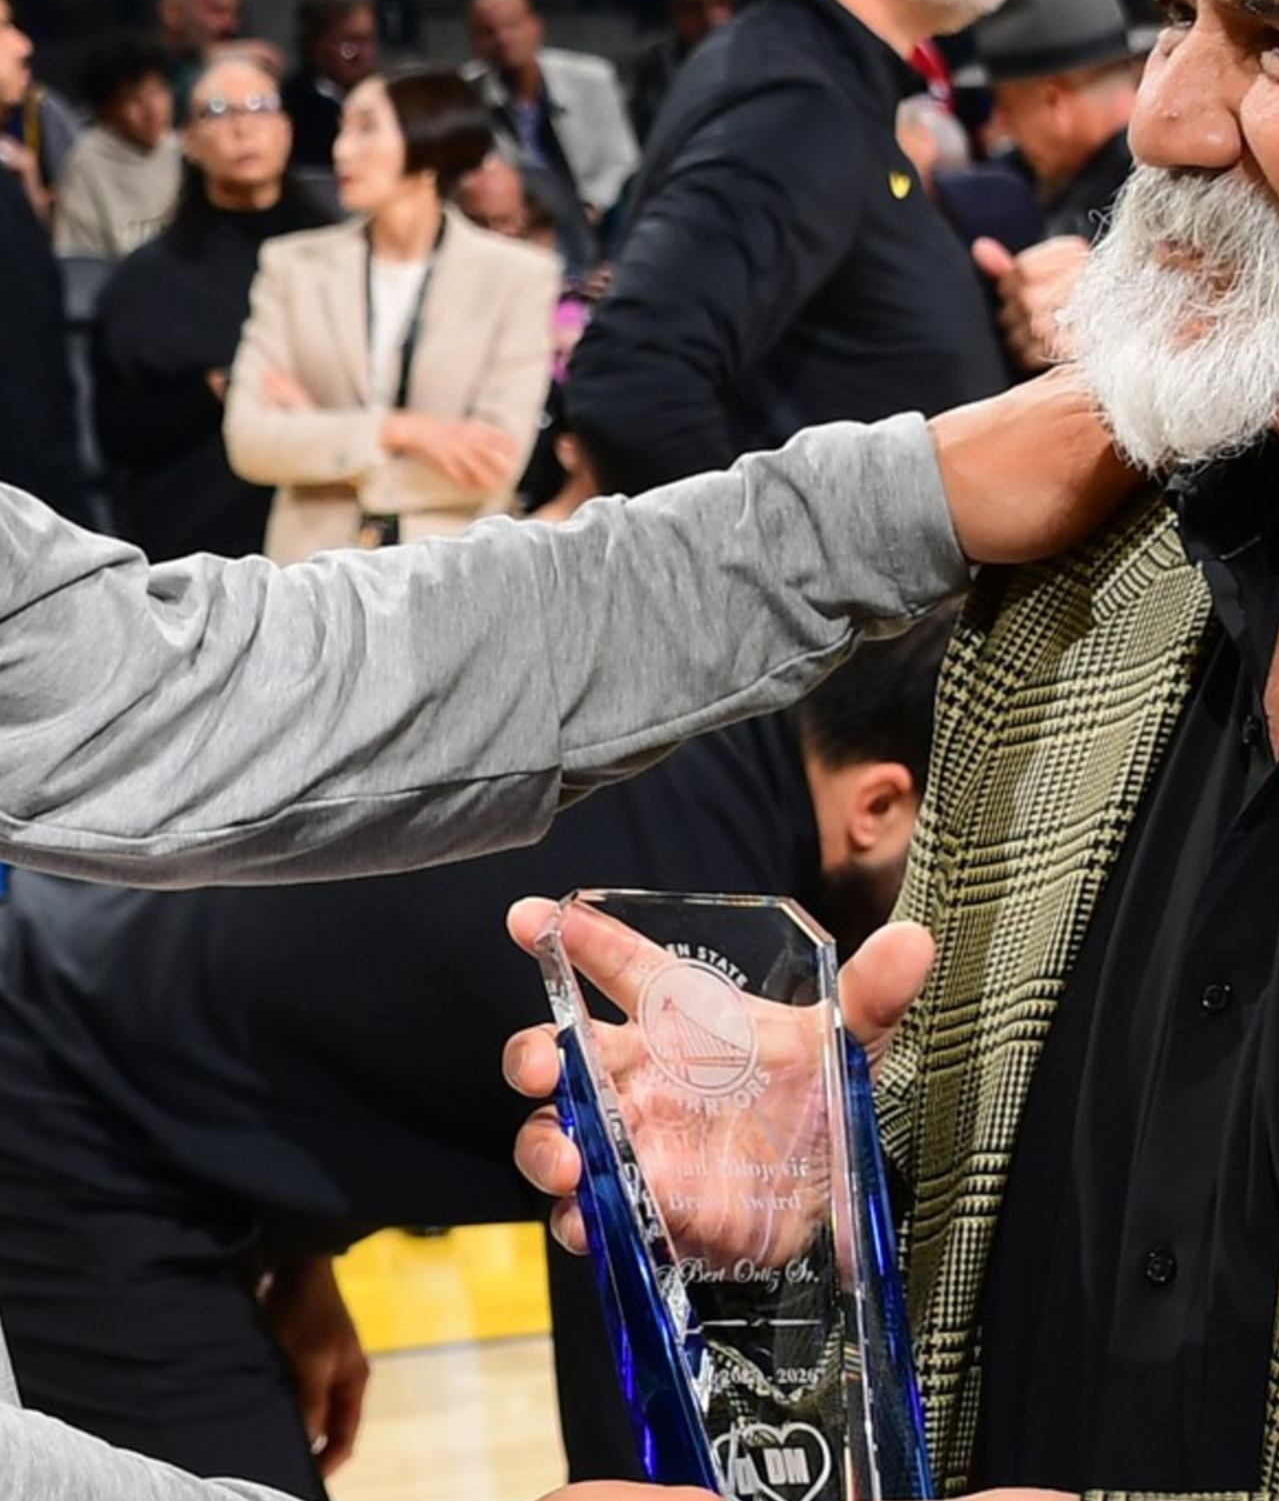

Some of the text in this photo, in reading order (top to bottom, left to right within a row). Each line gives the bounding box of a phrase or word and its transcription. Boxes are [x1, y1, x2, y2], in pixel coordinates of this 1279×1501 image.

[630, 943, 749, 990] GOEN STATE
[677, 1256, 820, 1293] Bert Ortiz Sr.
[763, 1447, 811, 1486] DM
